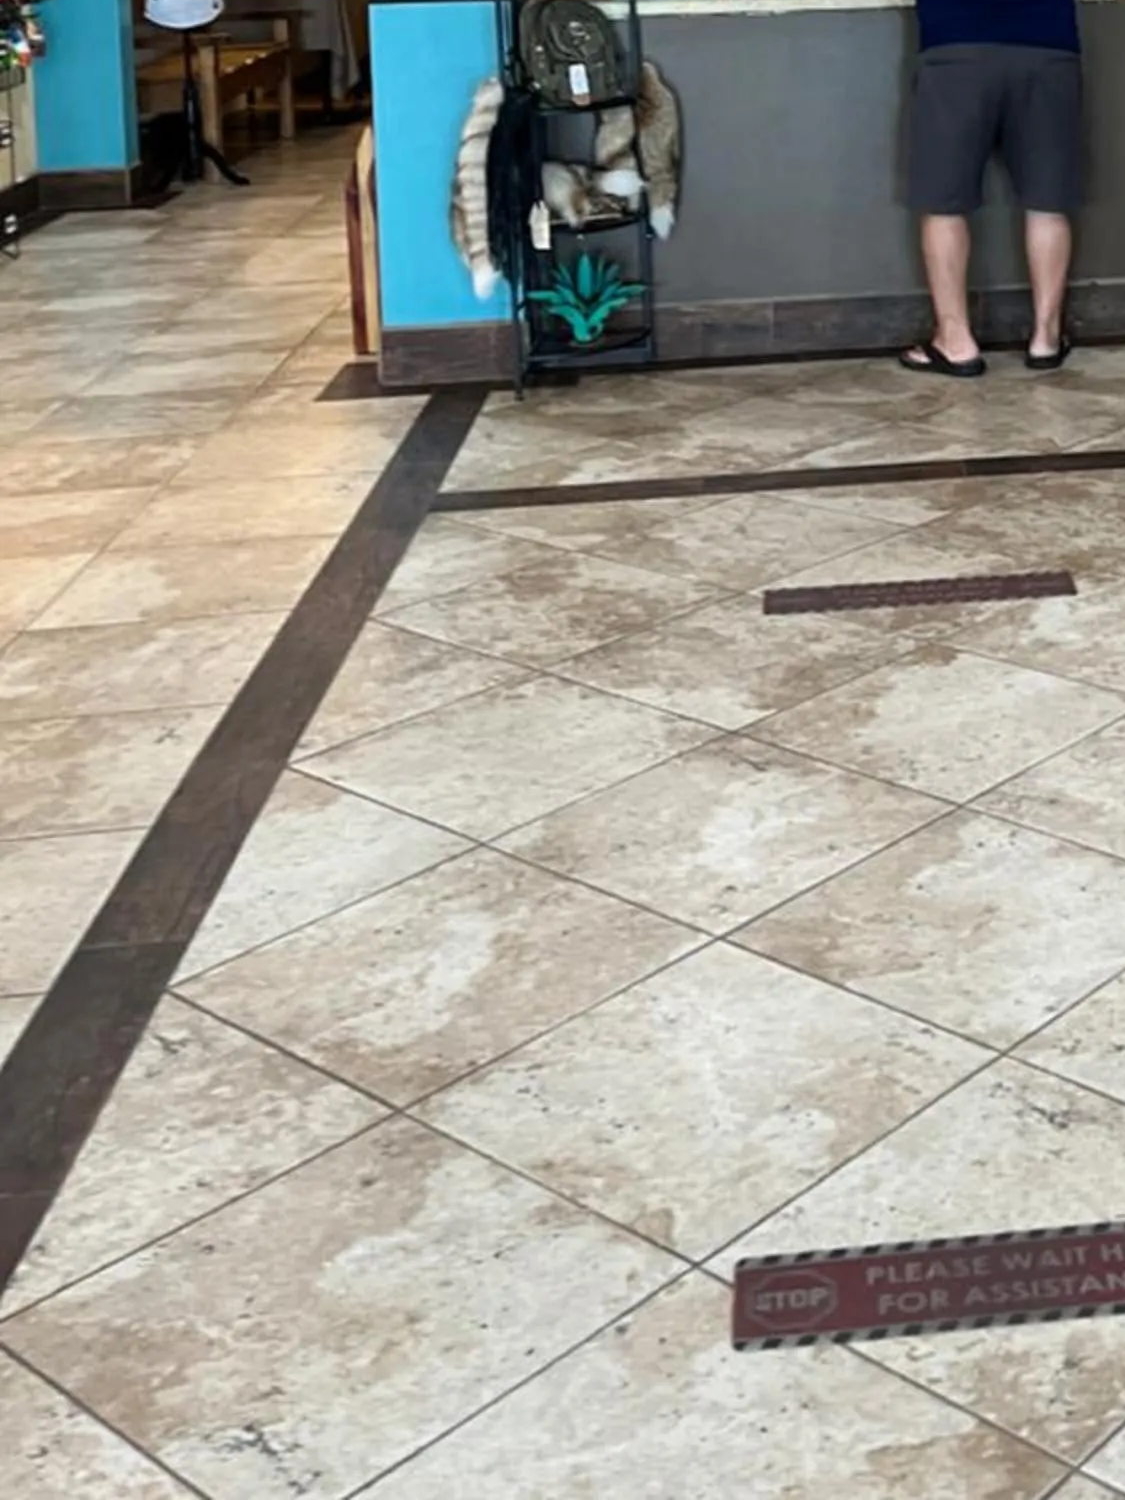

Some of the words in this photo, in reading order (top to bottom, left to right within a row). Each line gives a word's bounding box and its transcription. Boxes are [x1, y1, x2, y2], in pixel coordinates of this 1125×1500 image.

[865, 1255, 990, 1285] PLEASE
[1001, 1244, 1088, 1271] WAIT
[755, 1286, 829, 1312] STOP
[878, 1290, 951, 1316] FOR
